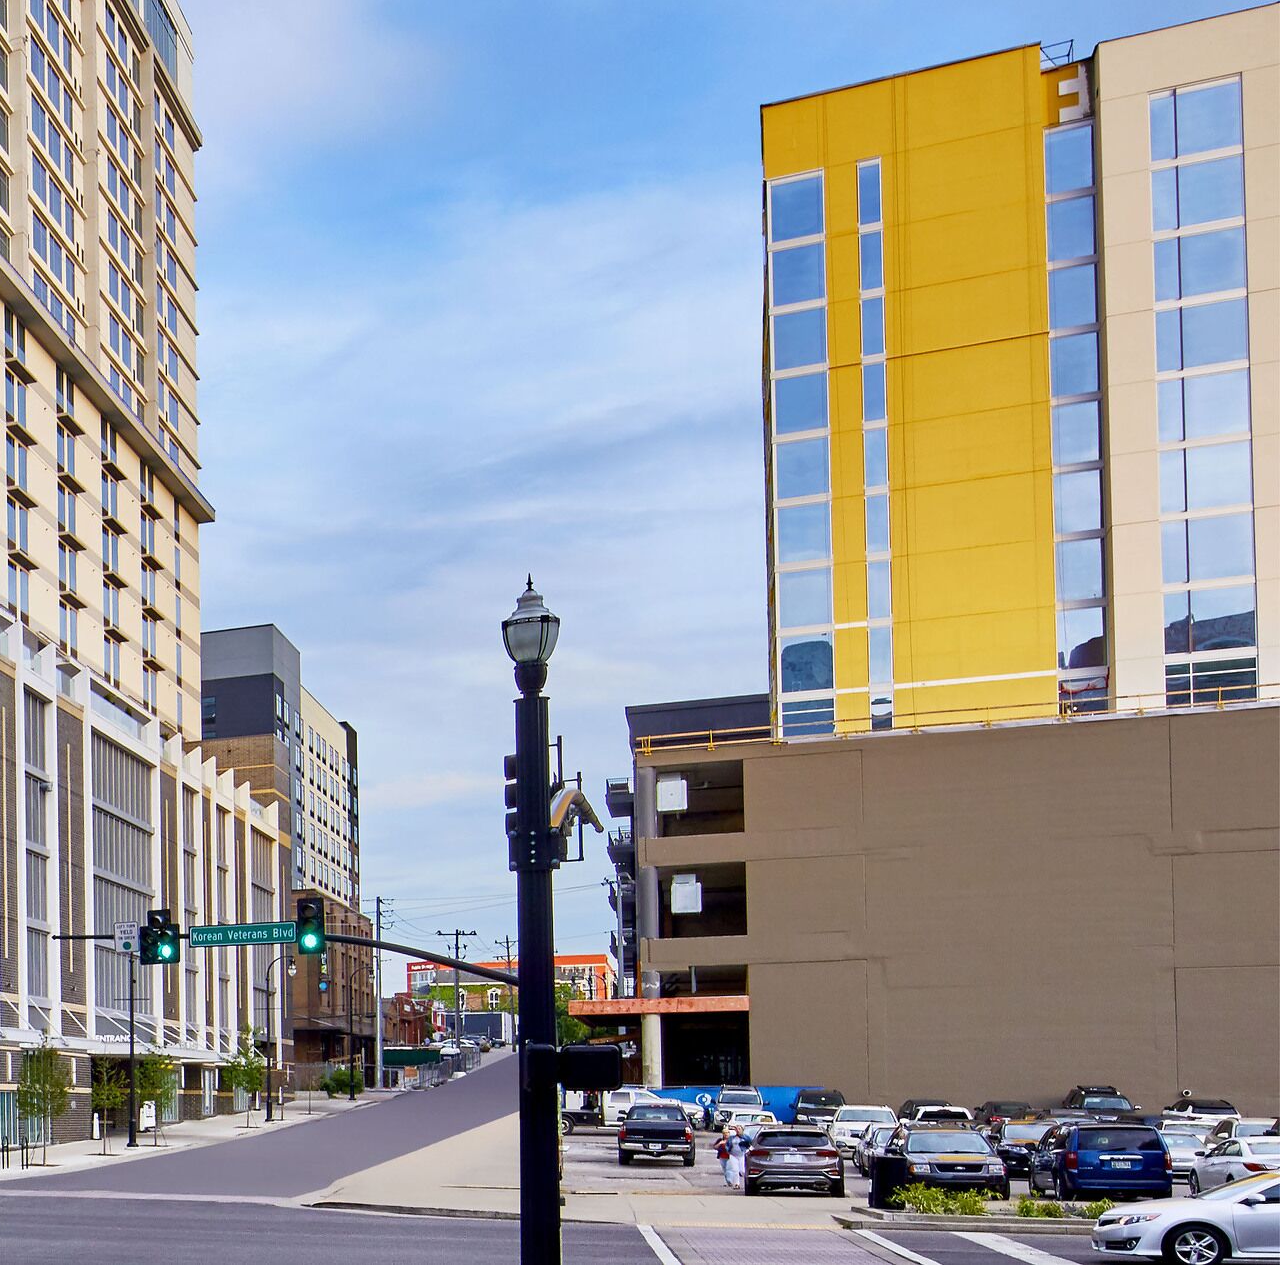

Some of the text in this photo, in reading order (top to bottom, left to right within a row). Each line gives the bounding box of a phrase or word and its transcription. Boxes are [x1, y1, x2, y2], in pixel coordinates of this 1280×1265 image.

[192, 928, 293, 942] Korean Veterans Blvd
